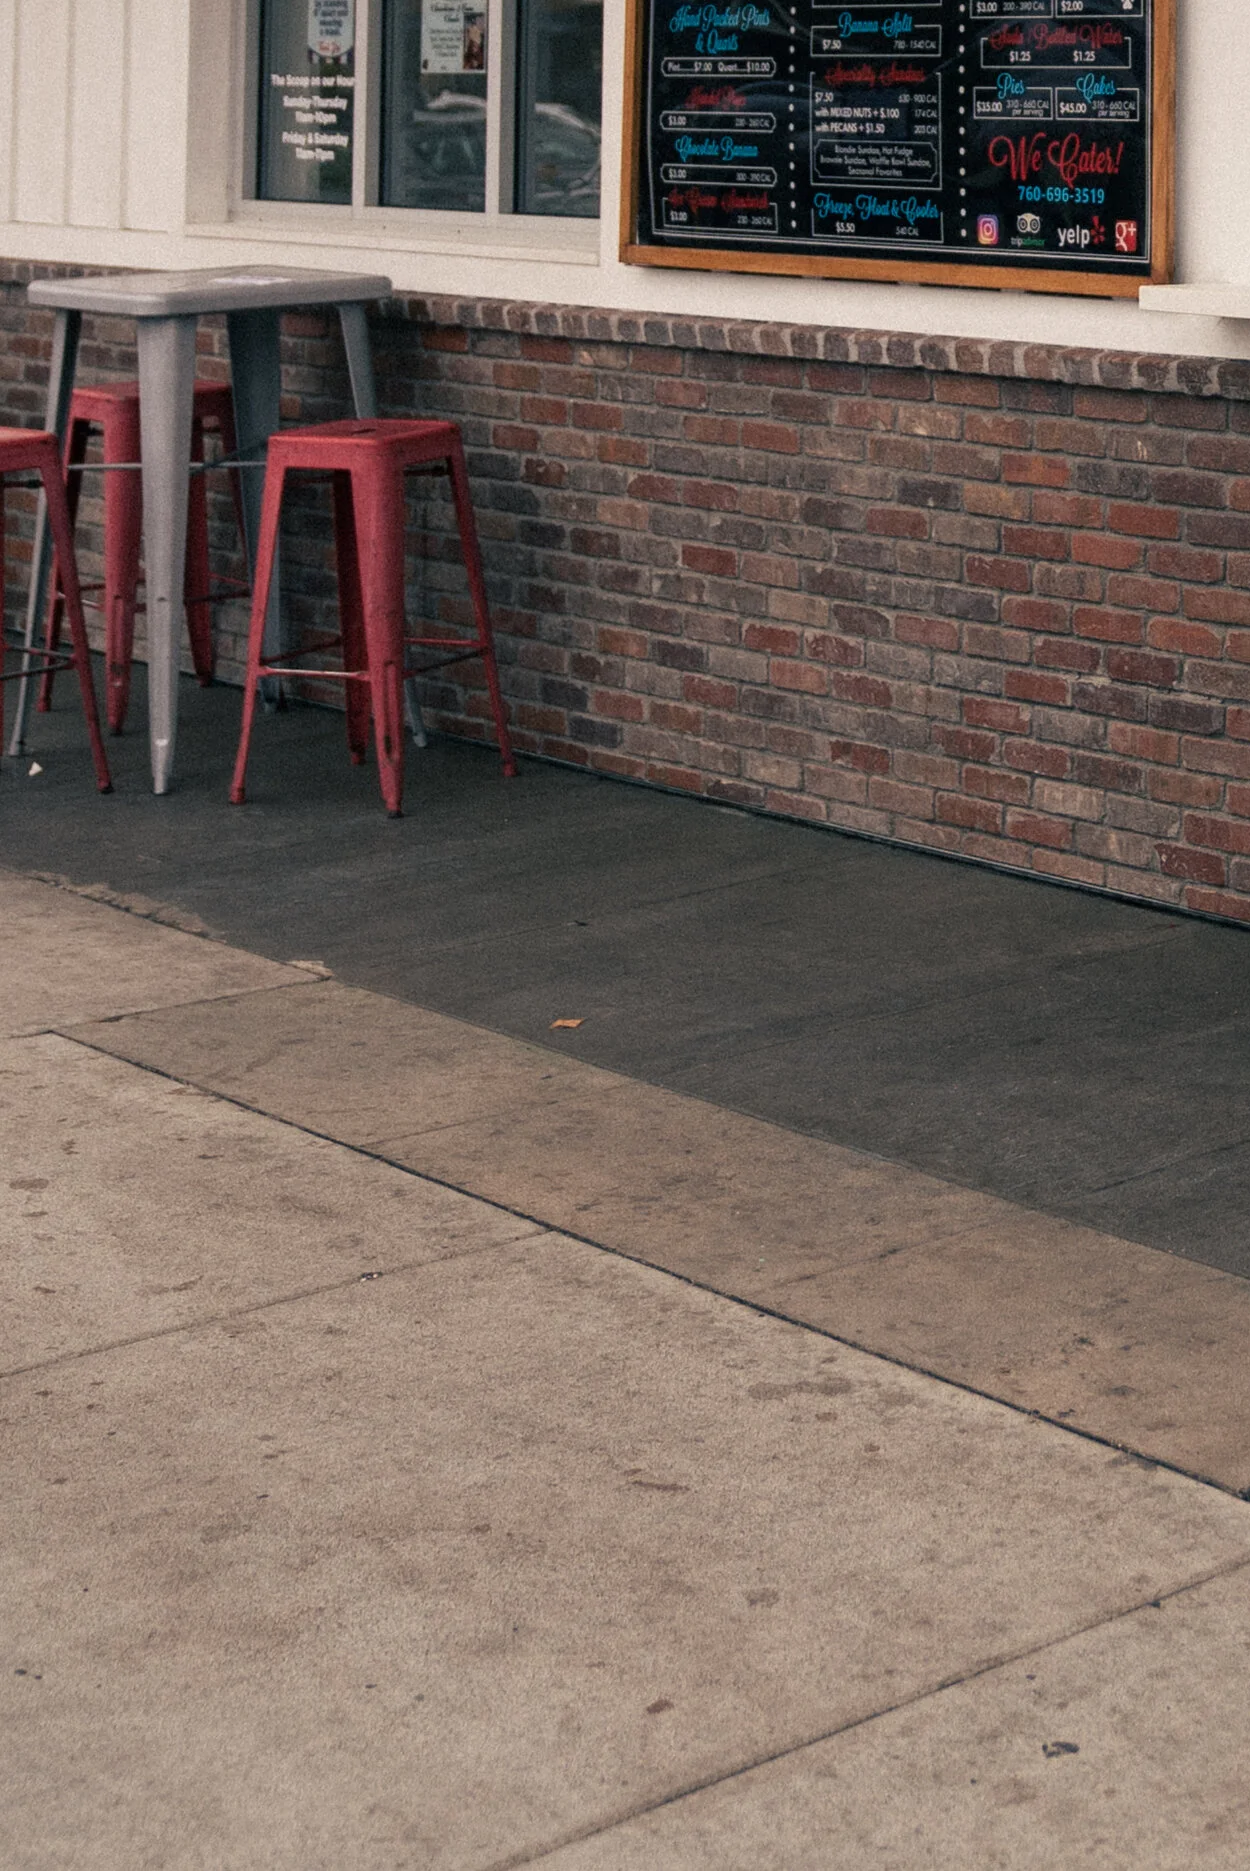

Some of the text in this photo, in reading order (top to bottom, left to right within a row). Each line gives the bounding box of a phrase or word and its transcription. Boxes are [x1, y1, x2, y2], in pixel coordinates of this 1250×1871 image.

[976, 2, 997, 13] $3.00
[1061, 0, 1083, 11] $2.00
[1009, 51, 1096, 62] $1.25 $1.25
[271, 74, 285, 86] The
[336, 74, 355, 86] Hour
[997, 72, 1026, 99] Pies
[1076, 72, 1116, 103] Cakes
[830, 108, 852, 118] MIXED
[853, 108, 871, 118] NUTS
[988, 131, 1124, 190] We Cater!
[1017, 185, 1105, 204] 760-696-3519
[1057, 224, 1091, 249] yelp
